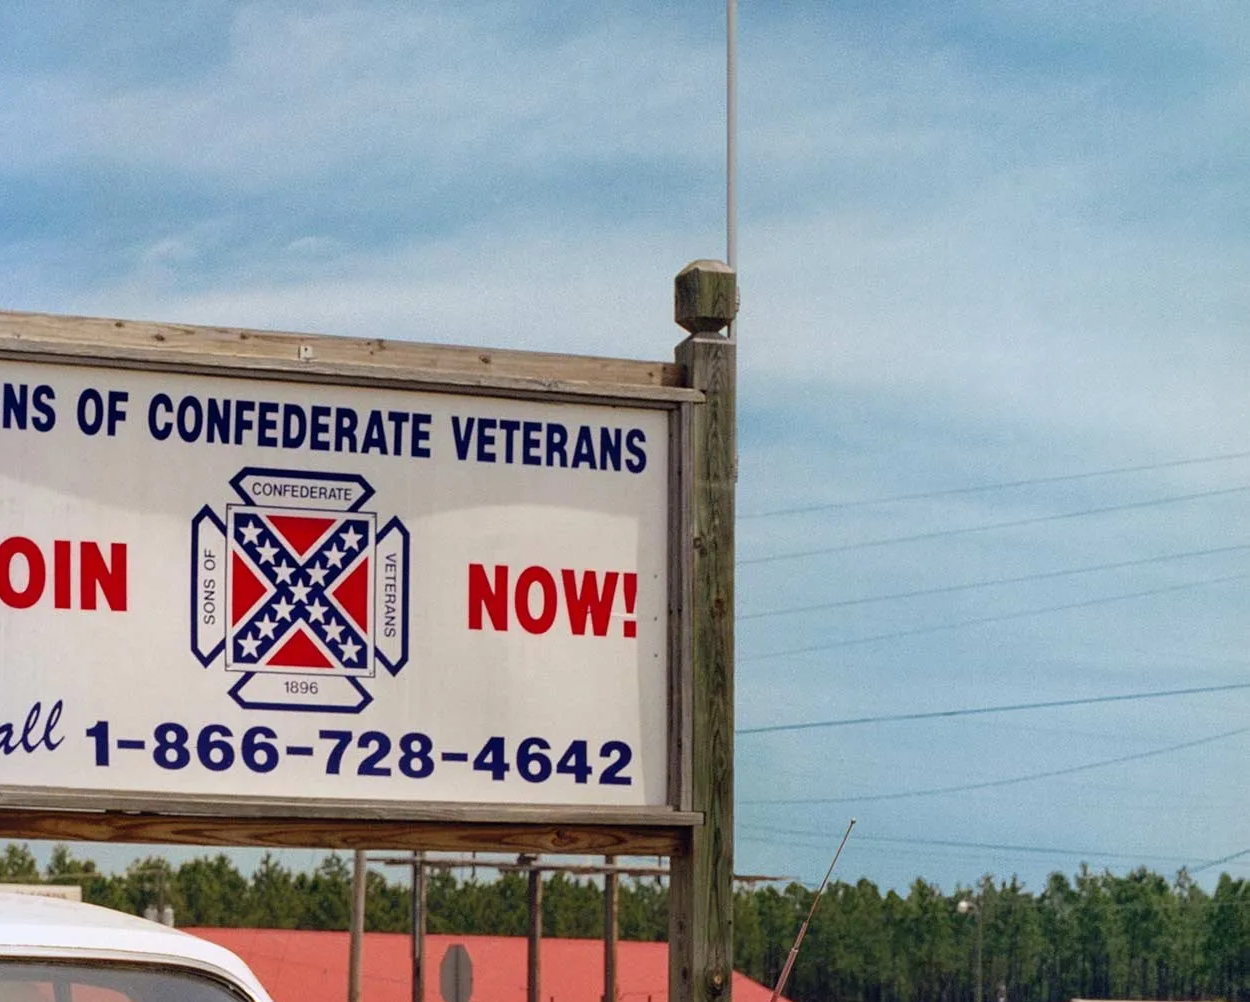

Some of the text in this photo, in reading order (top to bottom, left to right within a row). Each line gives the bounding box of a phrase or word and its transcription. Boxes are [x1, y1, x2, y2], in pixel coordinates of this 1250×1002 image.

[77, 387, 129, 436] OF
[149, 395, 432, 459] CONFEDERATE
[450, 415, 648, 475] VETERANS
[251, 482, 353, 502] CONFEDERATE
[203, 549, 216, 625] SONS OF
[384, 553, 397, 638] VETERANS
[467, 563, 638, 639] NOW!
[283, 681, 319, 695] 1896
[85, 720, 633, 786] 1-866-728-4642
